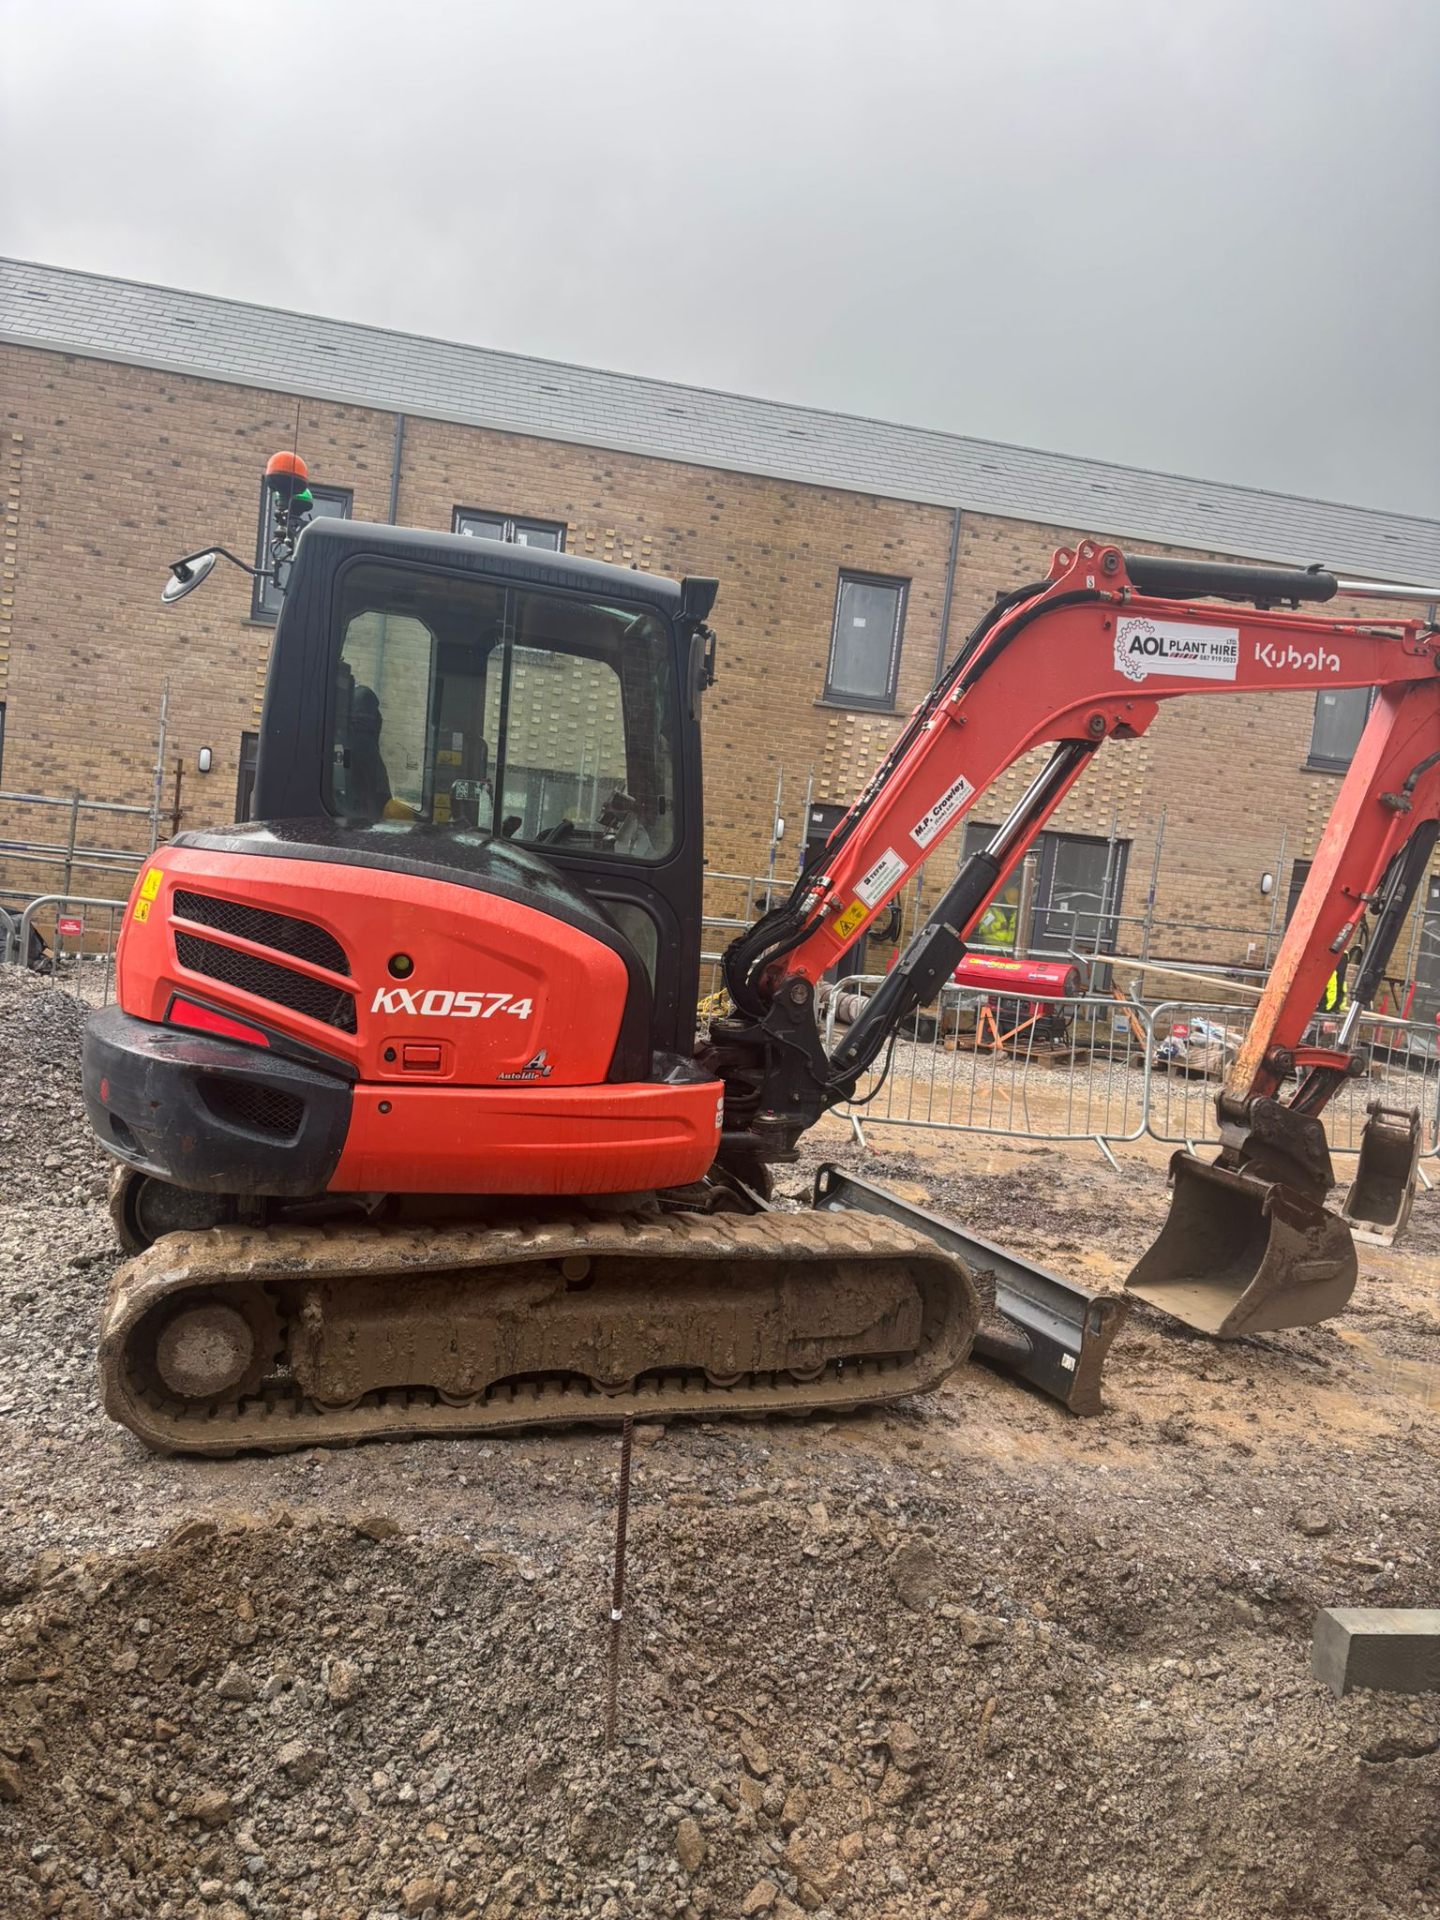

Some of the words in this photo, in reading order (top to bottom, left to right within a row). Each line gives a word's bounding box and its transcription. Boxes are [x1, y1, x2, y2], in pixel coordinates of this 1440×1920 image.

[1128, 635, 1169, 657] AOL
[1169, 640, 1207, 653] PLANT
[1210, 644, 1237, 656] HIRE
[1254, 642, 1341, 672] Kubota
[914, 817, 933, 837] M.P.
[932, 780, 964, 816] Crowley
[870, 861, 887, 879] TEFRA
[370, 987, 533, 1020] KX057-4
